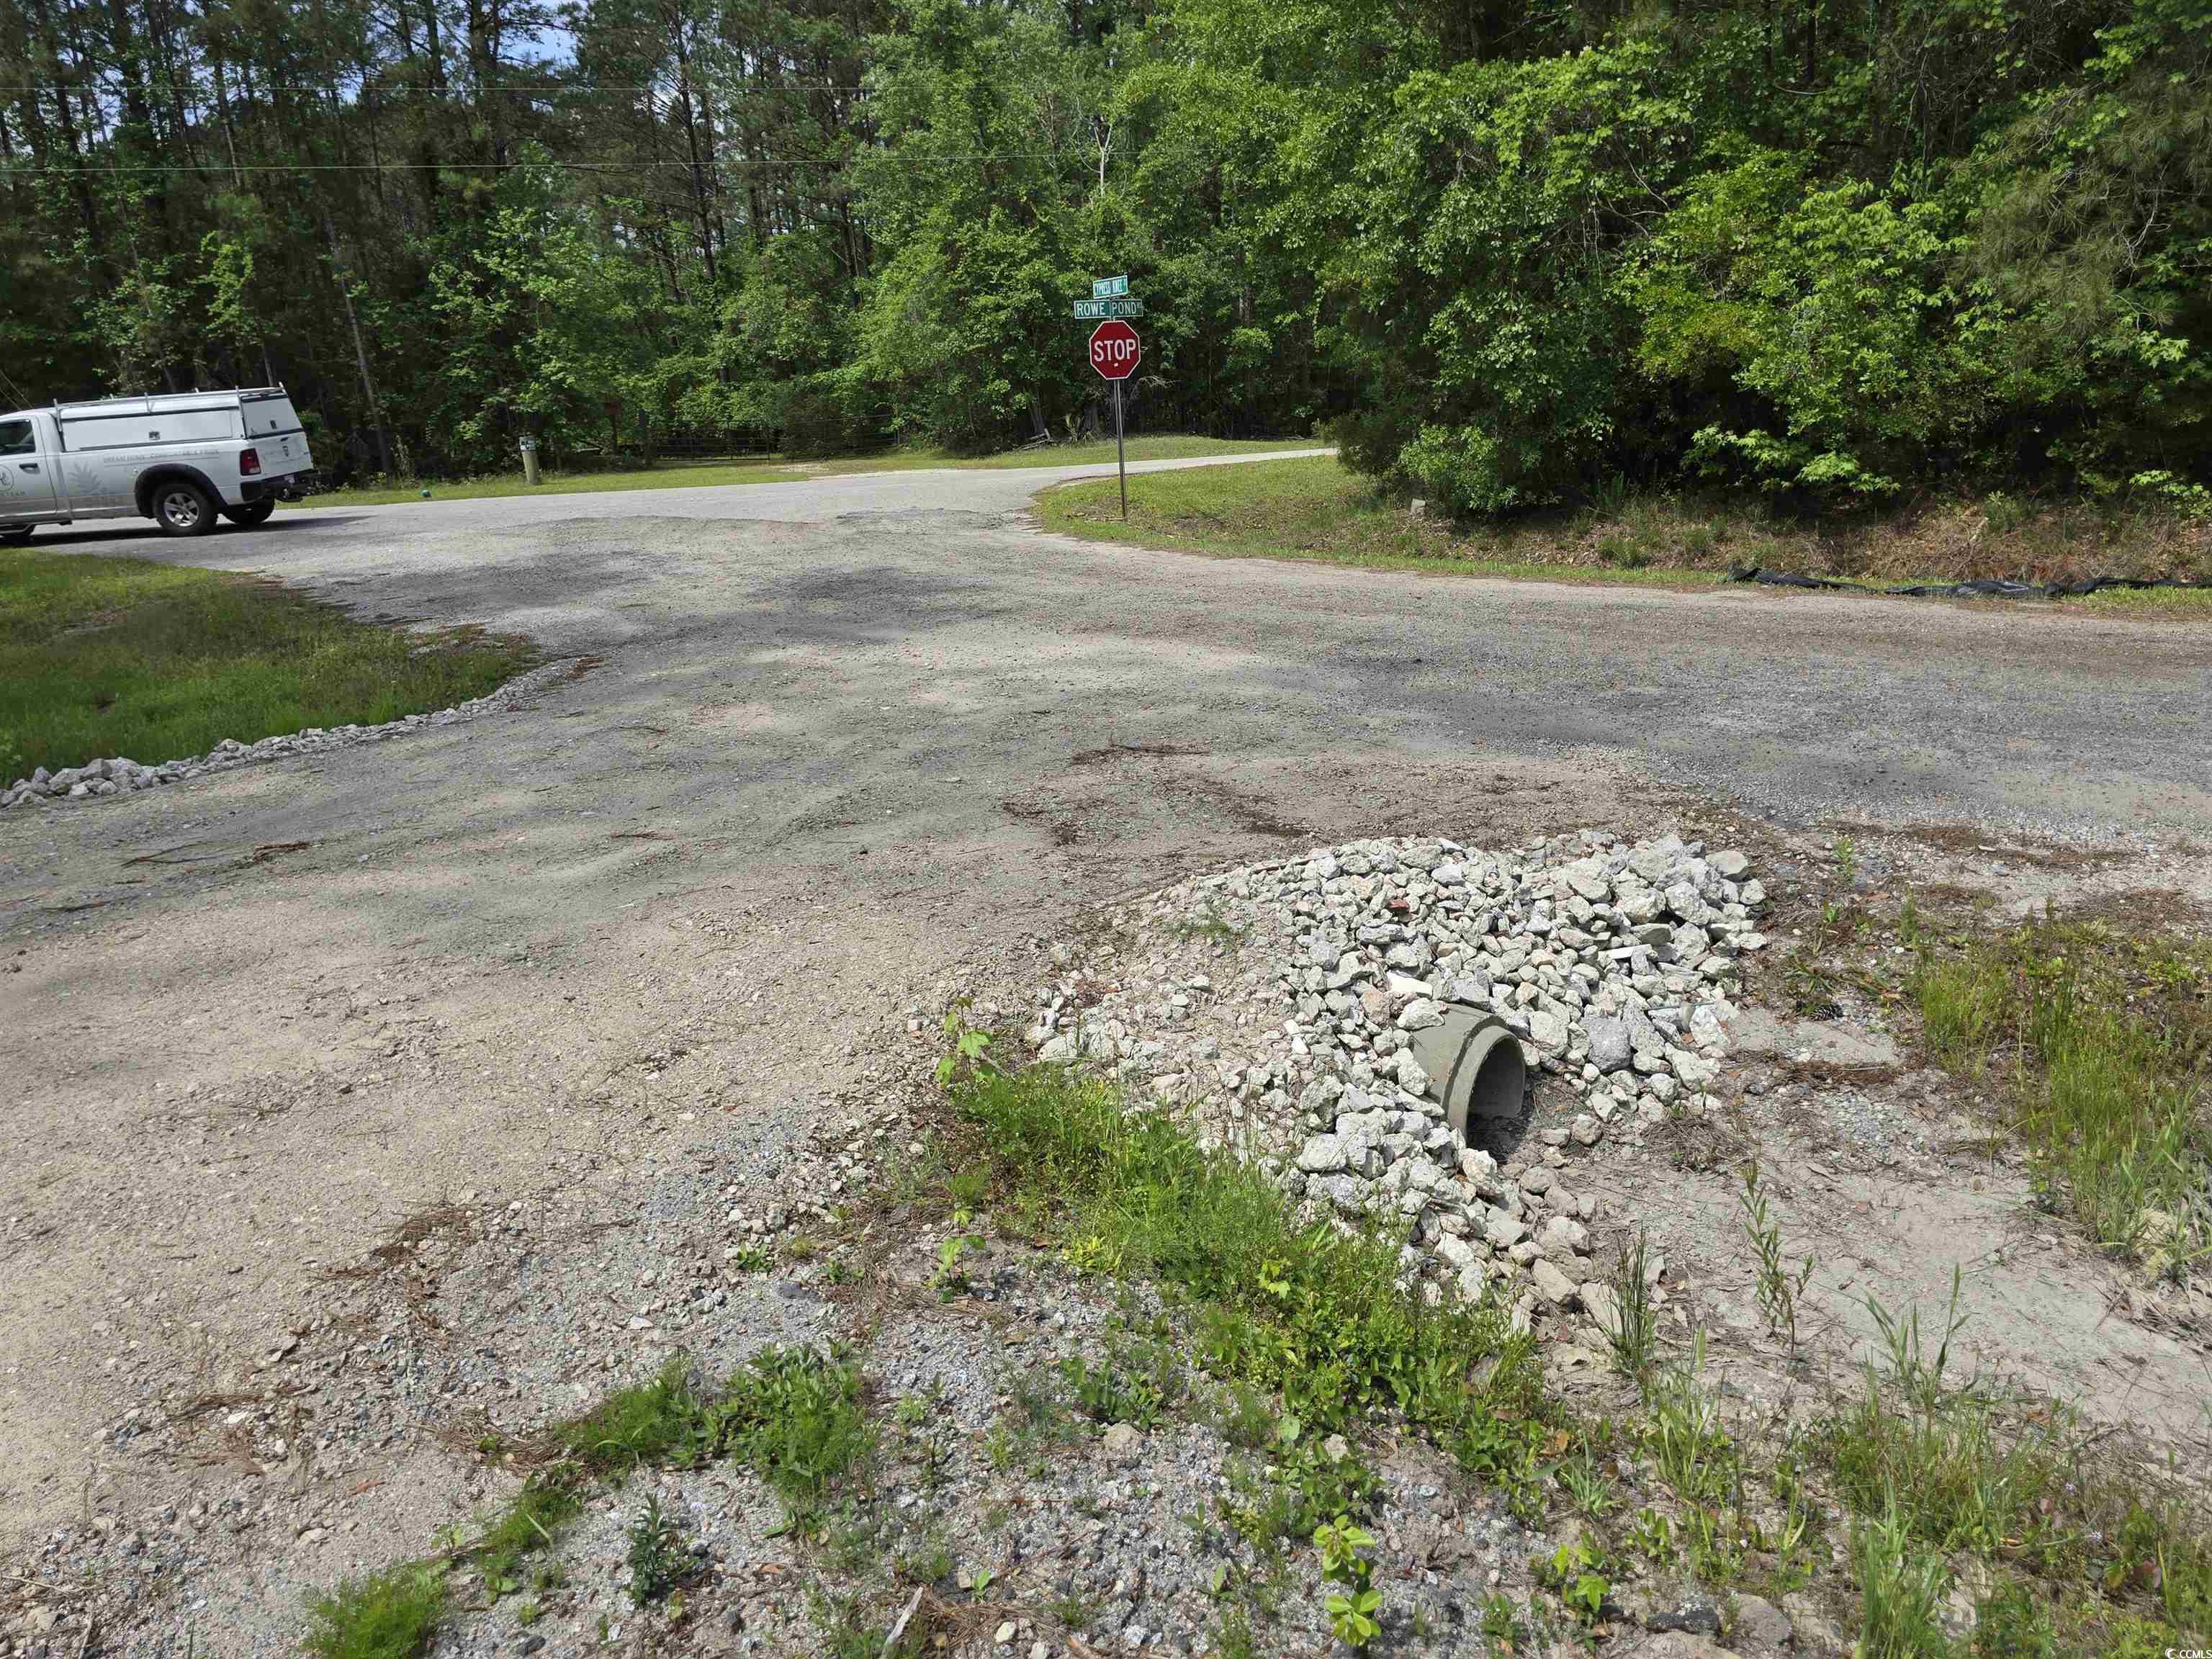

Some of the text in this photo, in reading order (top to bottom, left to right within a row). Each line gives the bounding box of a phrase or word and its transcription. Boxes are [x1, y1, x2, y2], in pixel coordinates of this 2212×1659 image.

[1076, 302, 1106, 316] ROWE
[1112, 302, 1136, 315] POND
[1094, 338, 1136, 361] STOP
